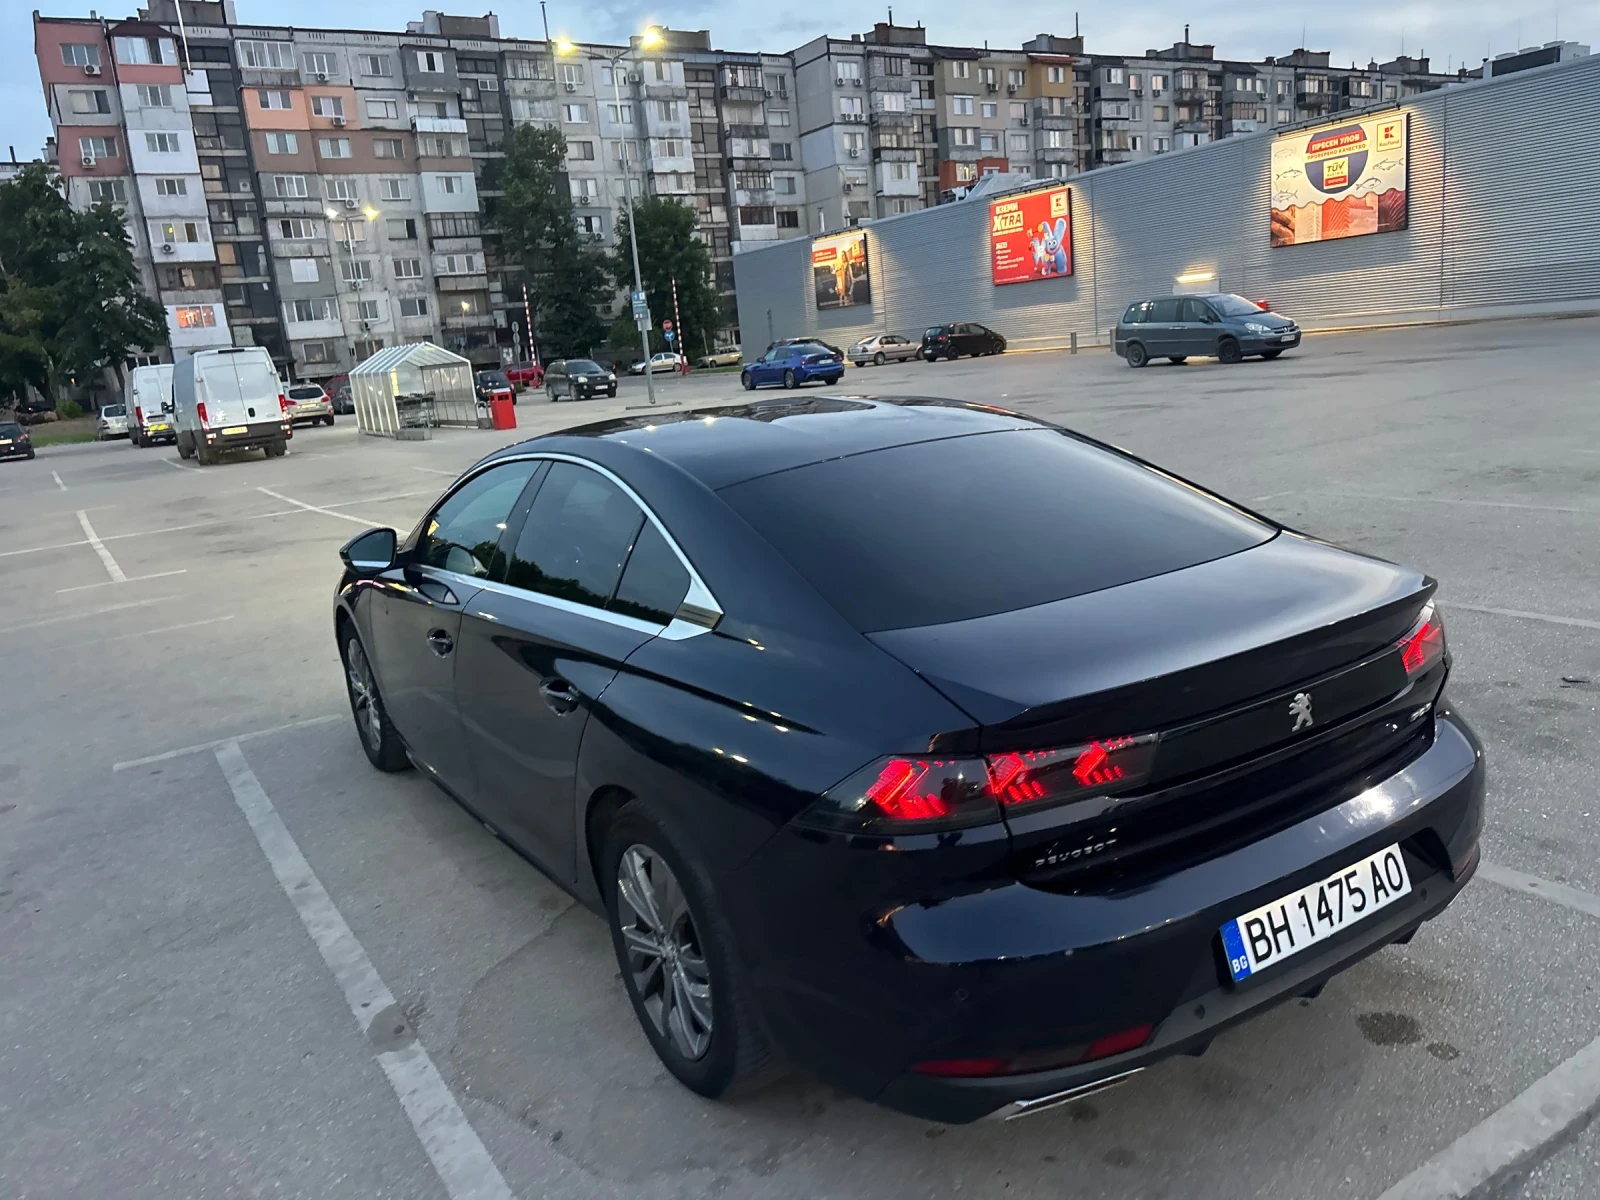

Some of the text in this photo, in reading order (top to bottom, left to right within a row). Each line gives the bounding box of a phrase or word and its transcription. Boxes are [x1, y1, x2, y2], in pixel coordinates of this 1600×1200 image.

[1306, 143, 1367, 160] ПРОВЕРЕНО КАЧЕСТВО
[1311, 133, 1360, 152] ПРЕСЕН УЛОВ
[992, 213, 1023, 232] XTRA
[1244, 852, 1404, 964] BH 1475 AO
[1231, 955, 1248, 973] BG
